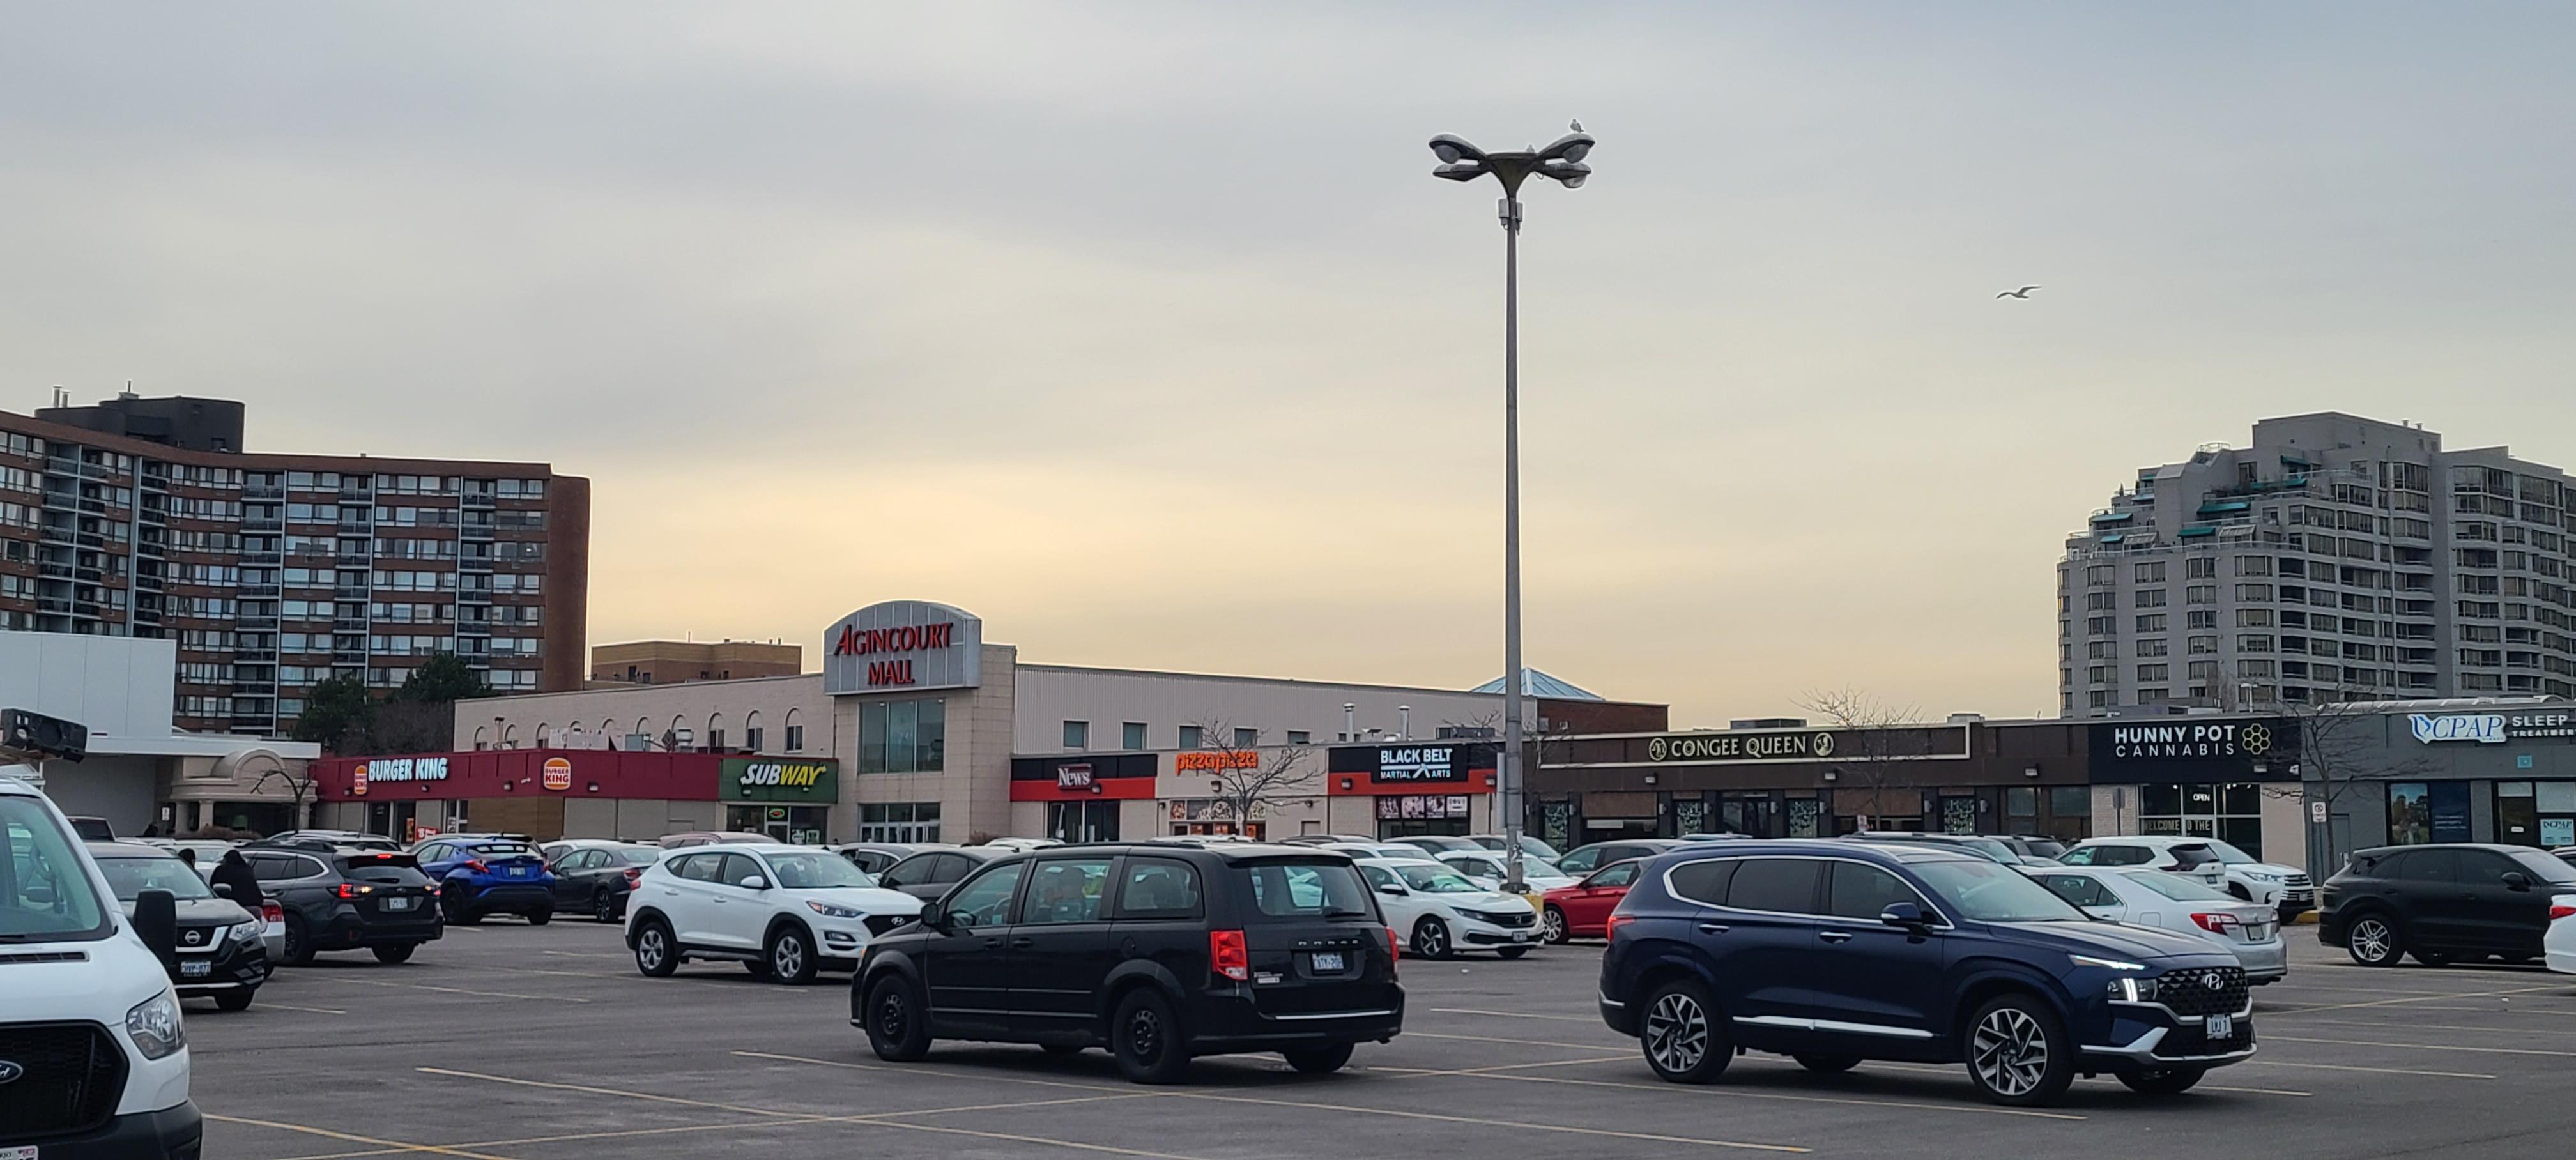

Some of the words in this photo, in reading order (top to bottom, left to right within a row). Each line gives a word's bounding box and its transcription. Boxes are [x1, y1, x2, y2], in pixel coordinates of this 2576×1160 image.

[834, 622, 953, 656] AGINCOURT
[867, 660, 915, 685] MALL
[2432, 716, 2503, 738] CPAP
[2511, 715, 2568, 727] SLEEP
[2115, 726, 2187, 744] HUNNY
[2194, 724, 2235, 742] POT
[1380, 749, 1422, 764] BLACK
[1423, 748, 1453, 763] BELT
[1671, 738, 1740, 757] CONGEE
[1745, 736, 1806, 758] QUEEN
[2115, 742, 2234, 758] CANNABIS
[368, 758, 413, 782] BURGER
[415, 757, 448, 781] KING
[545, 774, 569, 782] KING
[740, 763, 827, 786] SUBWAY
[1380, 770, 1411, 779] MARTIAL
[1431, 768, 1451, 778] ARTS
[2193, 793, 2211, 802] OPEN
[2194, 820, 2211, 830] THE
